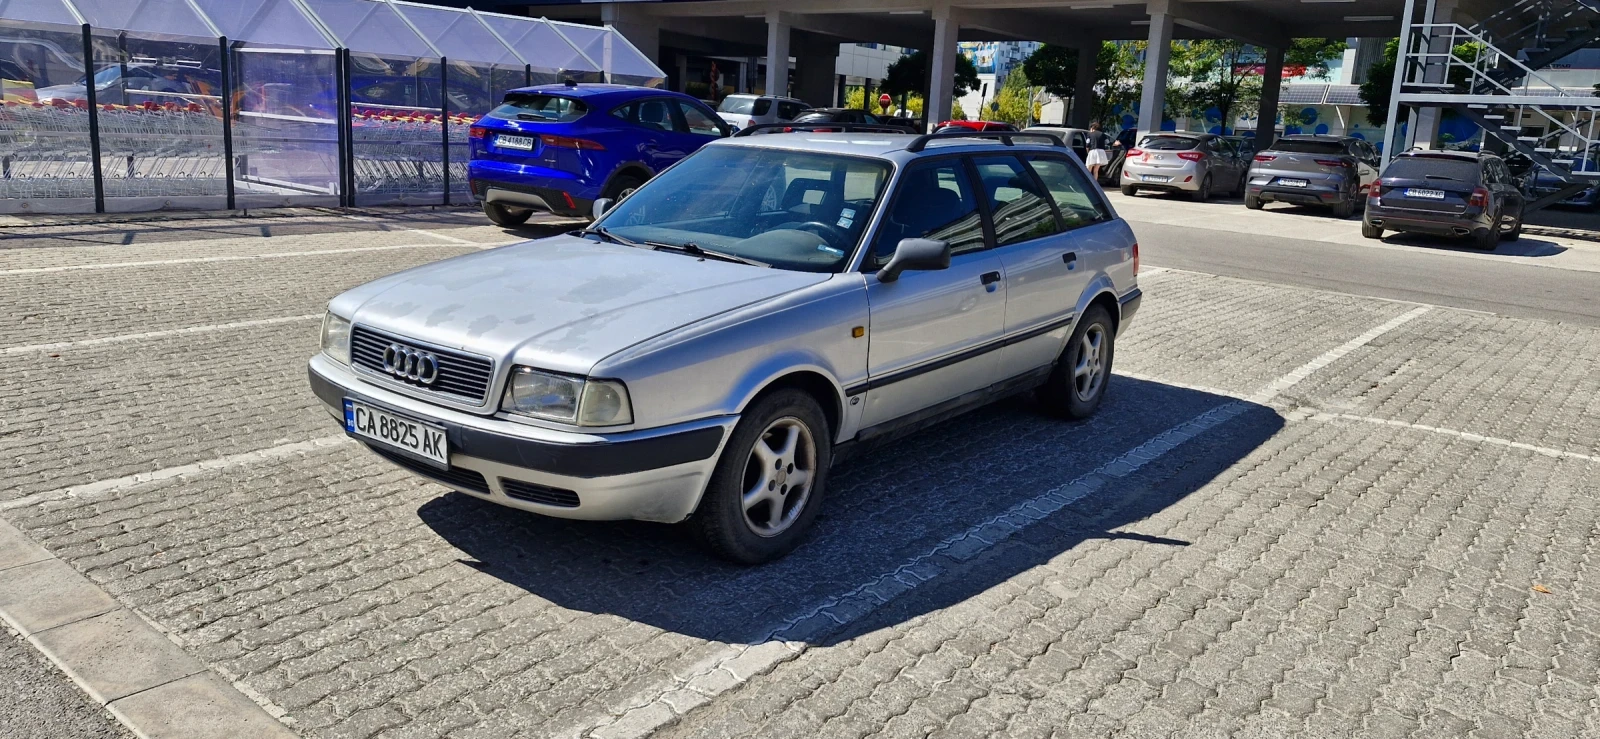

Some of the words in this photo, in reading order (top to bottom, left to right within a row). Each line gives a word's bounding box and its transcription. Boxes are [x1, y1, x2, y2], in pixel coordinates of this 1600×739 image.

[356, 407, 377, 436] CA
[380, 415, 419, 449] 8825
[423, 428, 444, 459] AK
